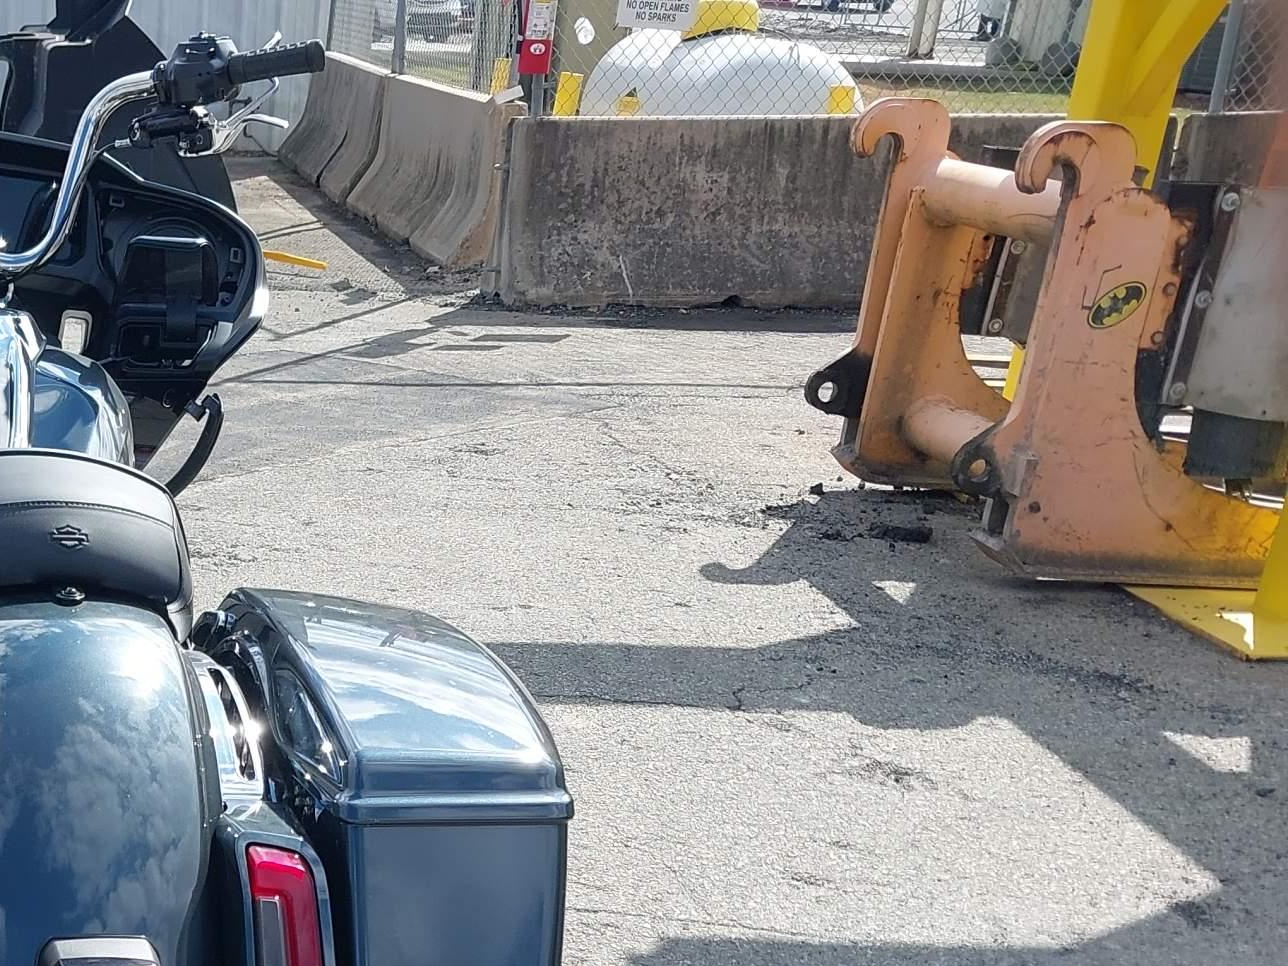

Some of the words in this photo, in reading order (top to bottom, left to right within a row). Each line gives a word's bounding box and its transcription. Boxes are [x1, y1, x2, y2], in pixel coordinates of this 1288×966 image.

[626, 0, 637, 9] NO
[639, 1, 659, 11] OPEN
[660, 2, 690, 13] FLAMES
[635, 11, 646, 20] NO
[648, 12, 677, 22] SPARKS
